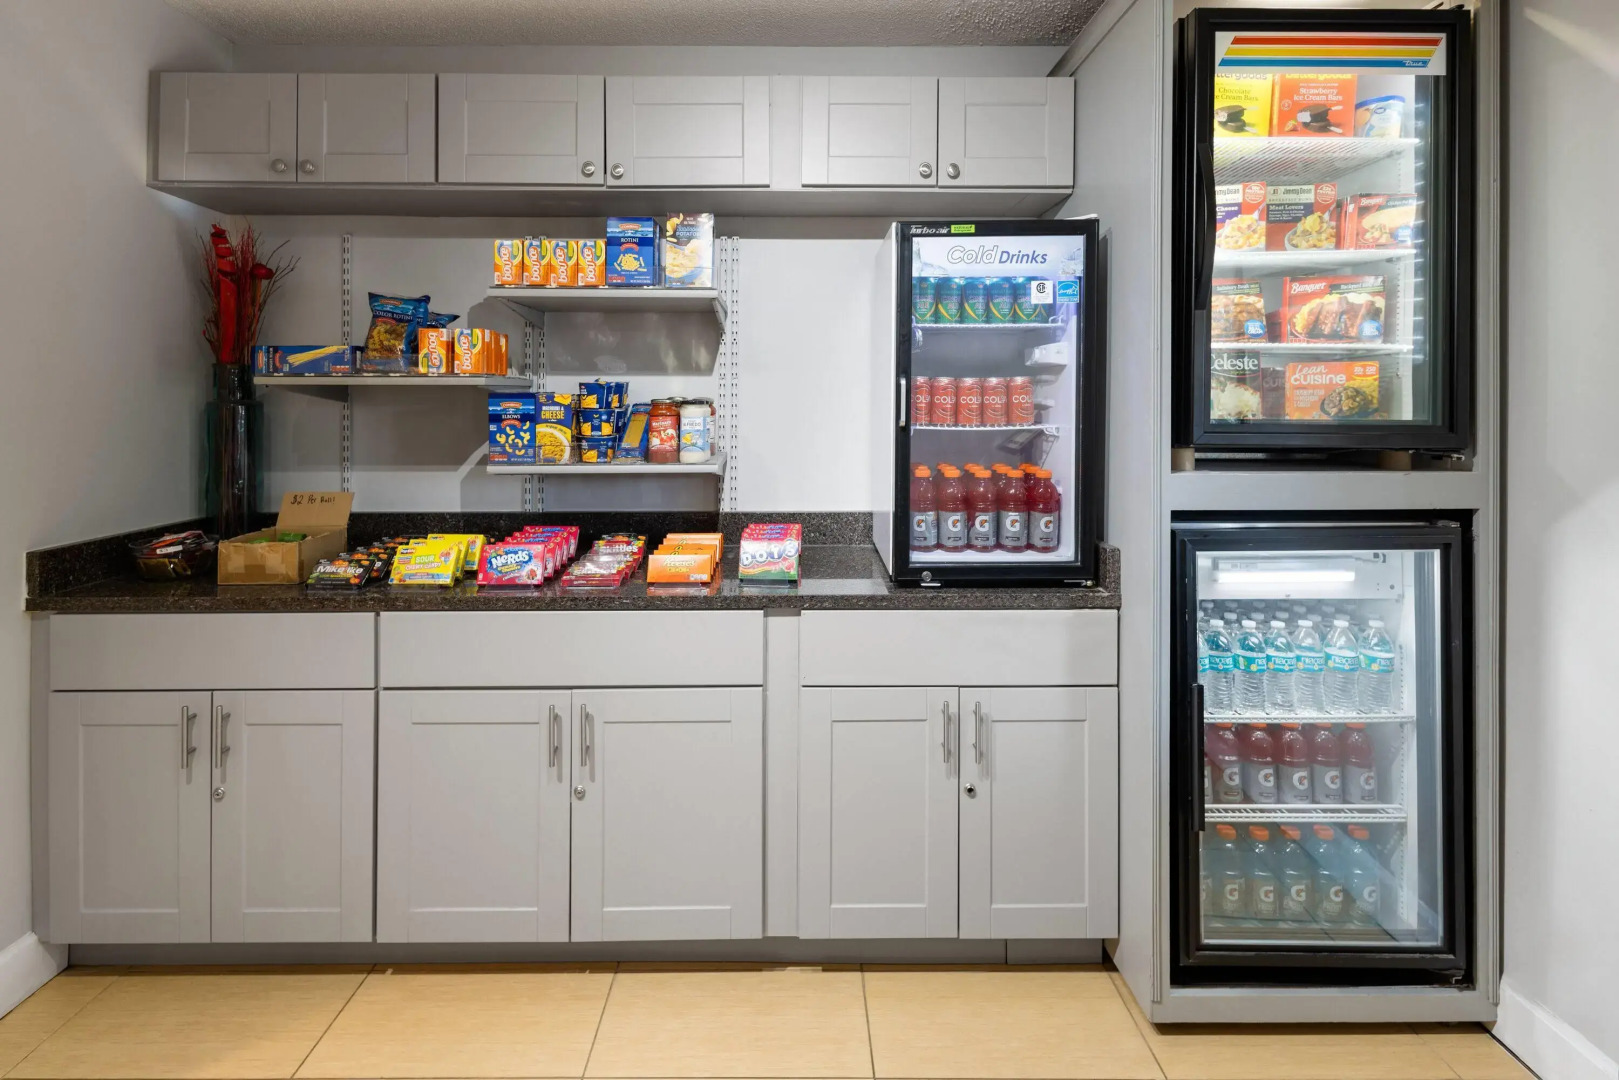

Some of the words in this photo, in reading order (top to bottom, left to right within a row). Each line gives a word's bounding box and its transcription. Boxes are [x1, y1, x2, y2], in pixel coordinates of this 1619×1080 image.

[1299, 87, 1338, 96] Strawberry
[910, 225, 936, 234] Turbo
[947, 245, 999, 264] Cold
[999, 250, 1048, 264] Drinks
[500, 246, 512, 281] bounce
[528, 246, 540, 282] bounce
[556, 247, 568, 282] bounce
[583, 246, 596, 282] bounce
[1291, 282, 1327, 294] Banquet
[428, 332, 440, 366] bounce
[460, 335, 472, 370] bounce
[1295, 364, 1328, 376] Lean
[542, 410, 564, 420] CHEESE
[914, 516, 926, 532] G
[948, 516, 960, 532] G
[974, 516, 989, 532] G
[1006, 516, 1020, 532] G
[1040, 516, 1054, 532] G
[415, 555, 435, 564] SOUR
[316, 565, 346, 573] Mike
[1222, 768, 1240, 786] G
[1258, 768, 1274, 786] G
[1292, 772, 1308, 790] G
[1324, 770, 1340, 789] G
[1359, 772, 1375, 790] G
[1224, 884, 1239, 900] G
[1259, 886, 1274, 902] G
[1290, 885, 1306, 902] G
[1330, 886, 1344, 902] G
[1363, 886, 1376, 901] G
